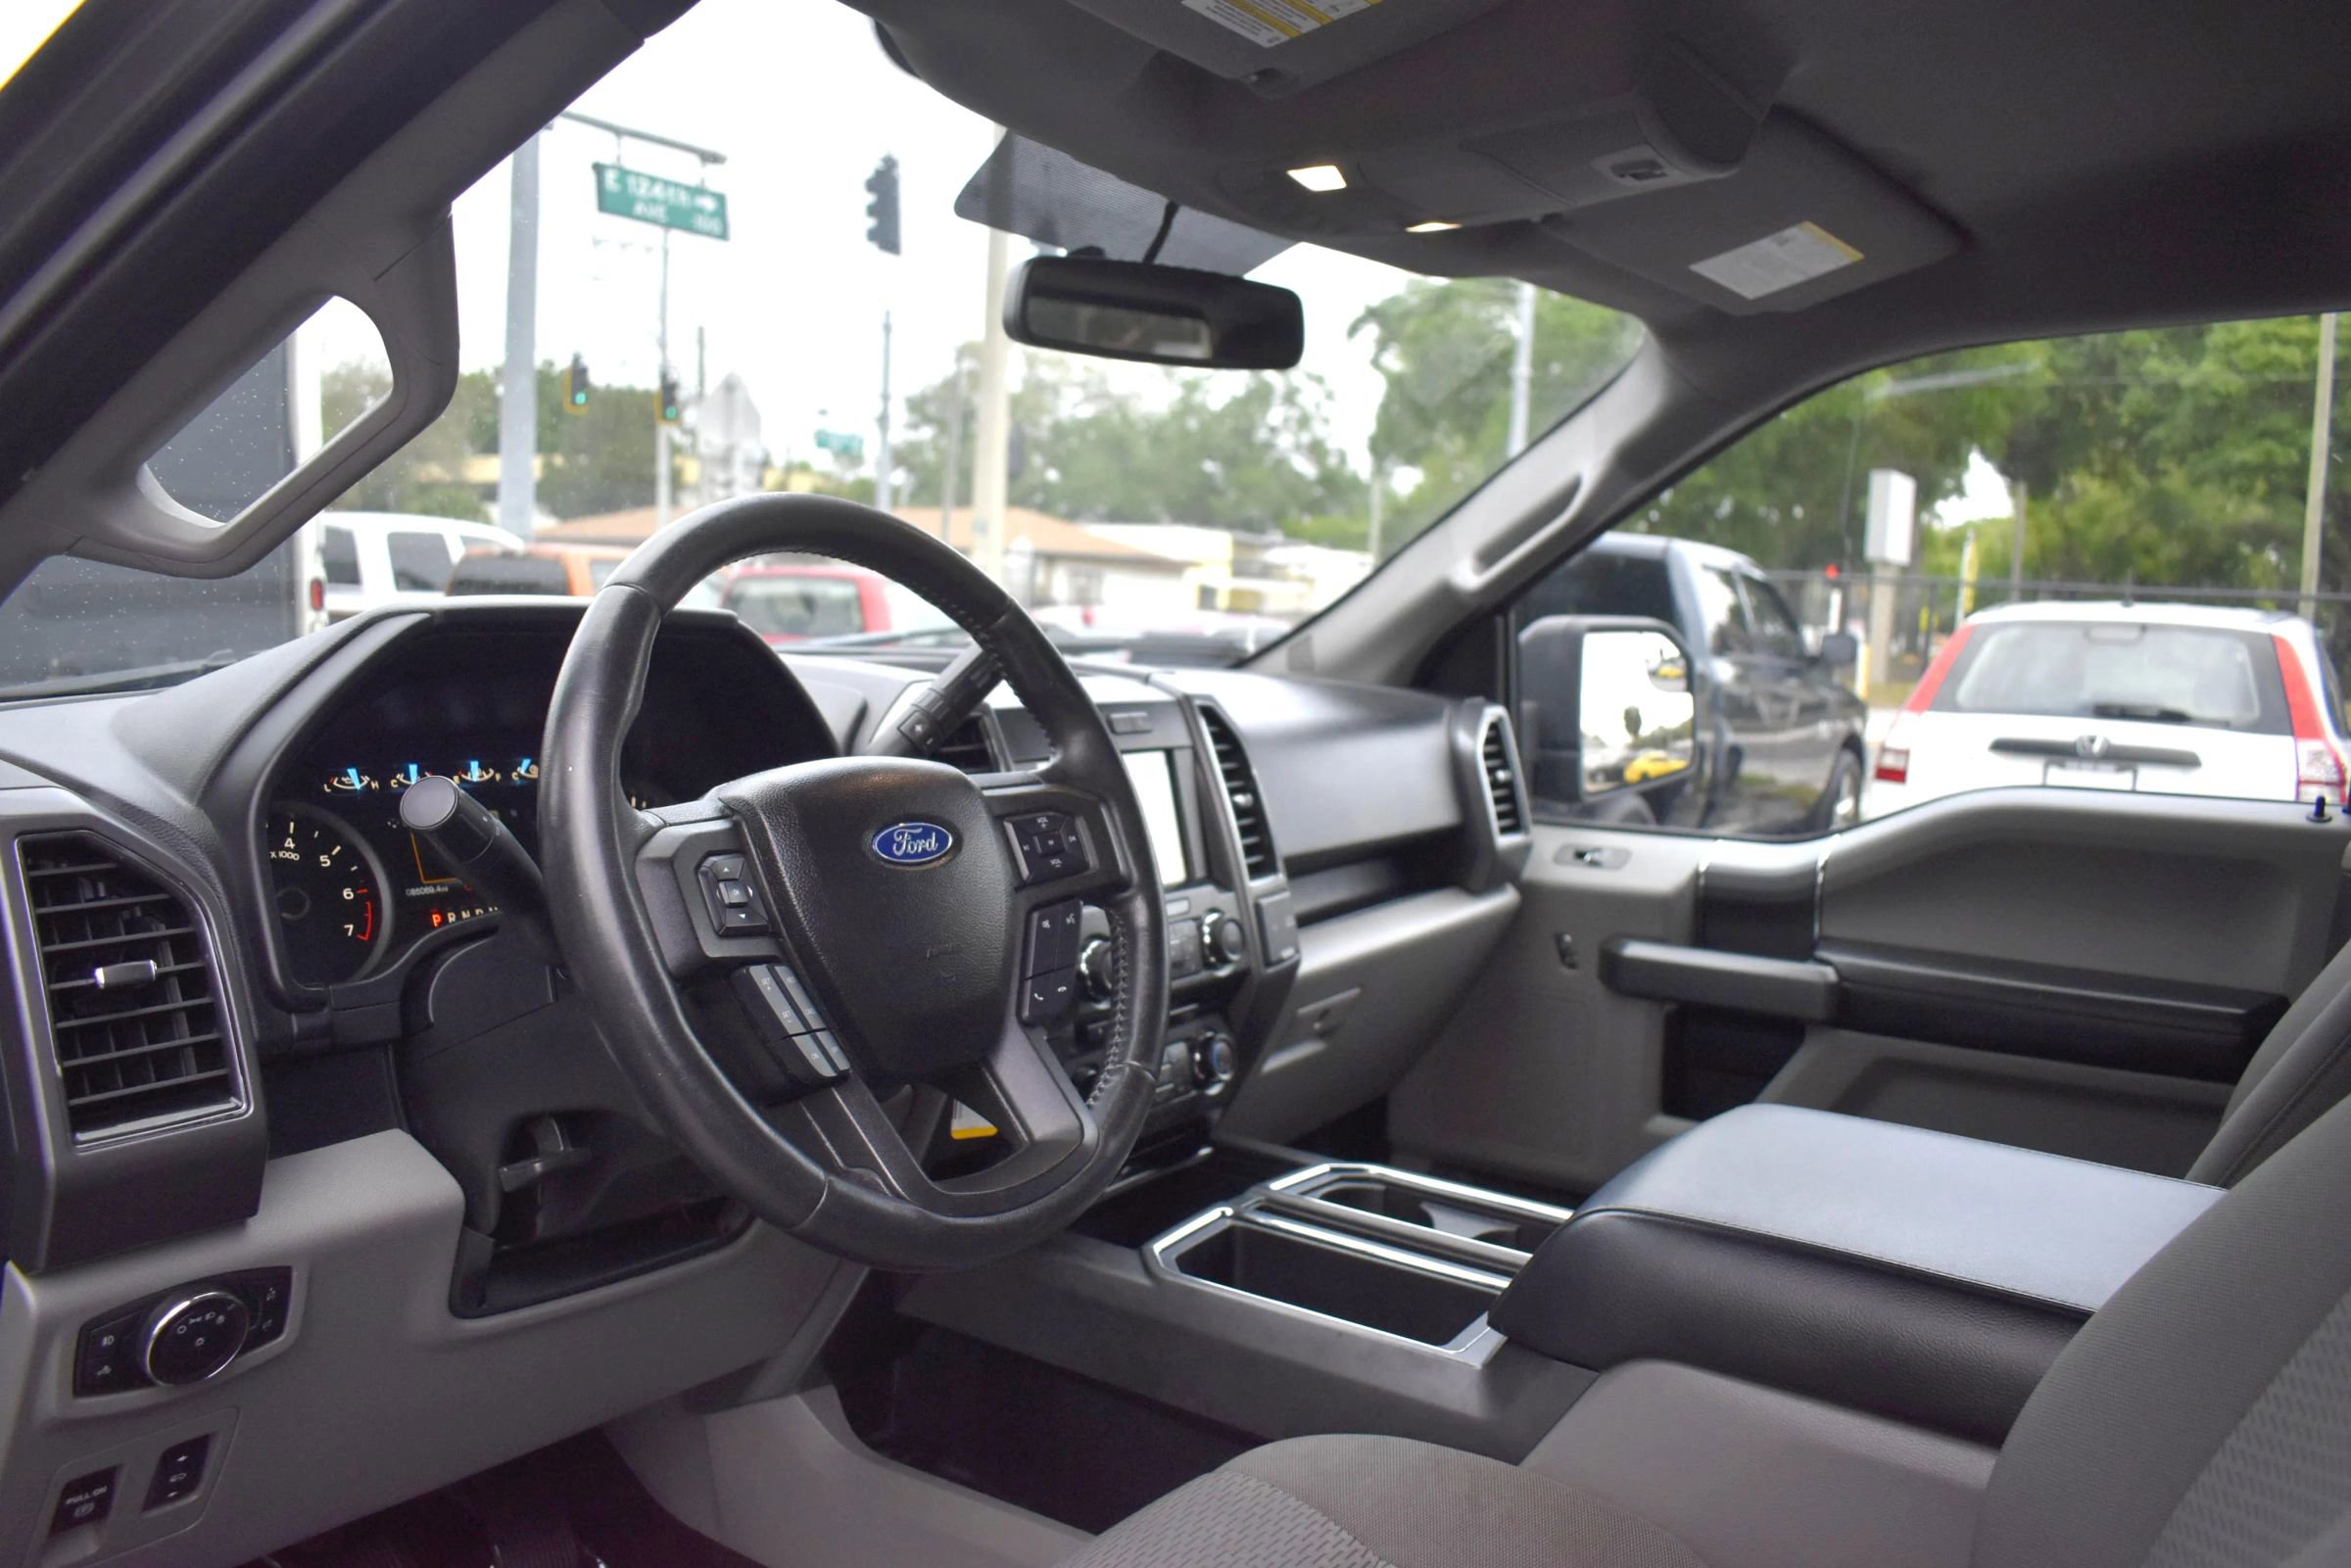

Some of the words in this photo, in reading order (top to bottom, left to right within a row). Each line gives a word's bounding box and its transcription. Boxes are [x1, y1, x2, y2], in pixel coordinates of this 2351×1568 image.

[390, 779, 399, 787] C
[284, 837, 296, 849] 4
[892, 827, 938, 857] Ford
[278, 850, 300, 861] 1000
[319, 854, 331, 867] 5
[343, 887, 355, 900] 6
[432, 914, 442, 927] P
[448, 912, 456, 923] R
[344, 924, 355, 936] 7
